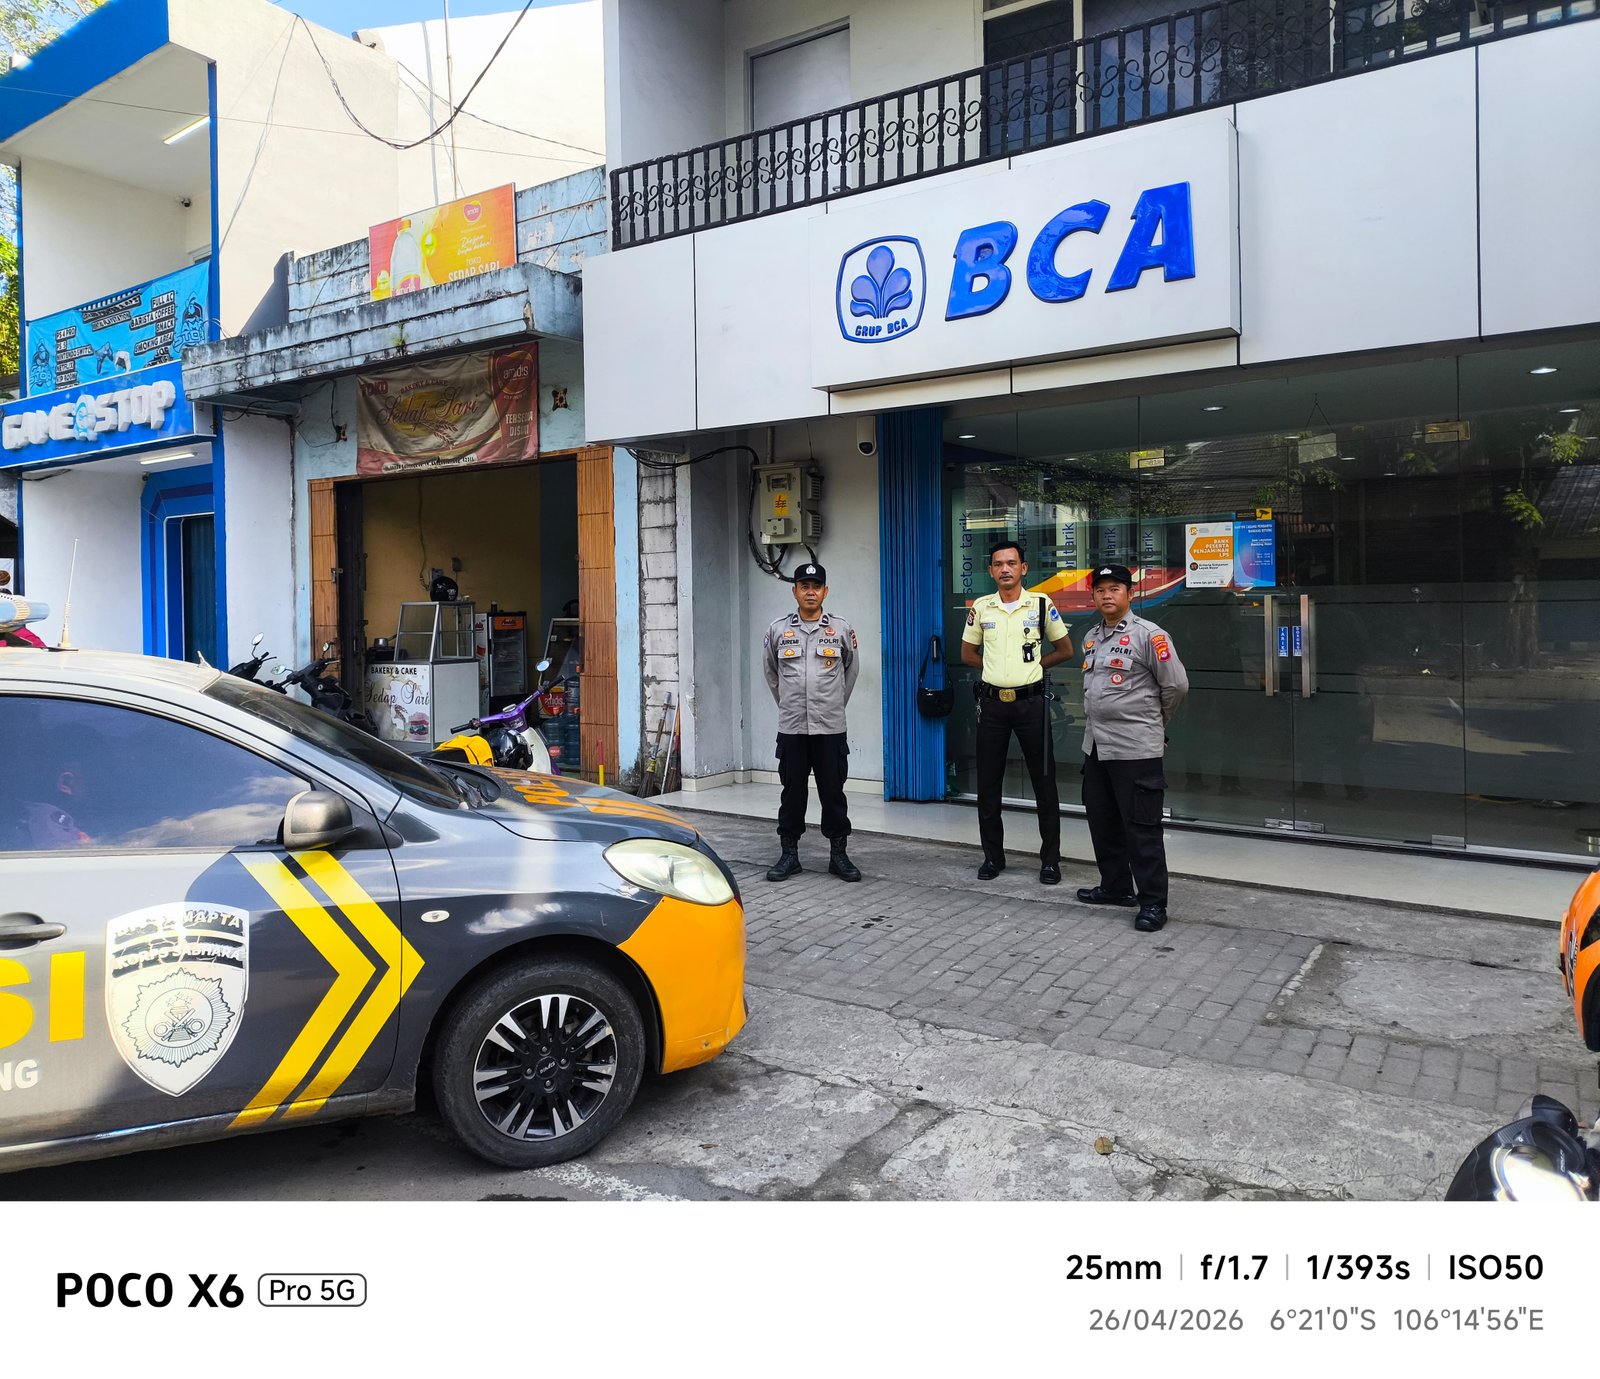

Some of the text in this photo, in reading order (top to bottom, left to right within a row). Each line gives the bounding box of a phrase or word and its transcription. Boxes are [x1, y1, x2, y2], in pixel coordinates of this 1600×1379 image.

[945, 181, 1195, 321] BCA
[155, 305, 174, 319] COFFEE
[855, 318, 908, 337] GRUP BCA
[3, 381, 175, 449] GAME STOP
[1062, 523, 1075, 554] tarik
[959, 512, 973, 594] setor tarik
[1110, 646, 1132, 655] POLRI
[371, 666, 417, 675] BAKERY & CAKE
[401, 680, 430, 705] Sari
